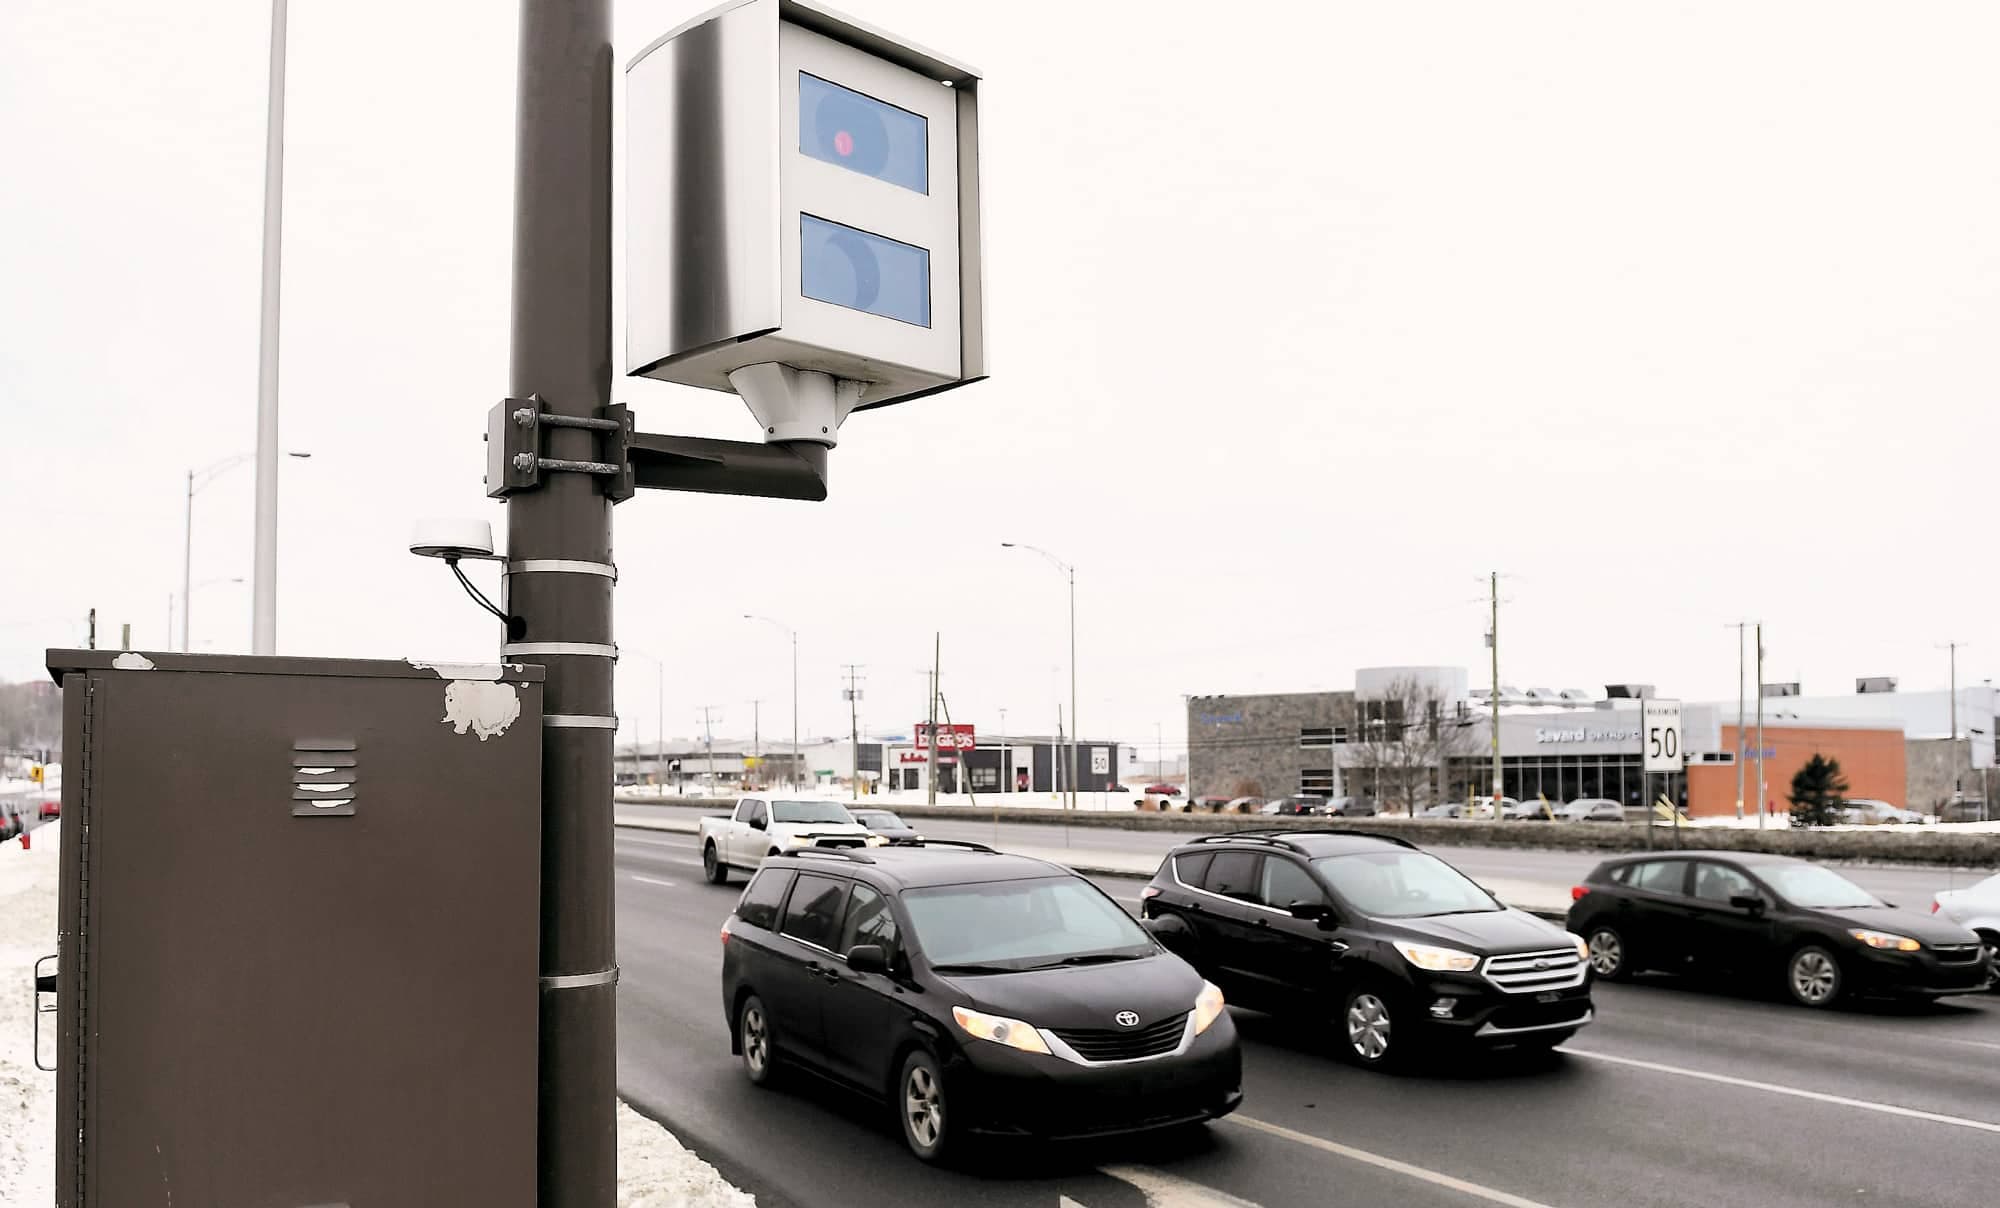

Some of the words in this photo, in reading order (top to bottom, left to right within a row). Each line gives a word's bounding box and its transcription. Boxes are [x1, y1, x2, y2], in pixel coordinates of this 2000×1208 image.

[1537, 727, 1585, 743] Savard
[1651, 727, 1677, 758] 50
[1095, 757, 1107, 770] 50
